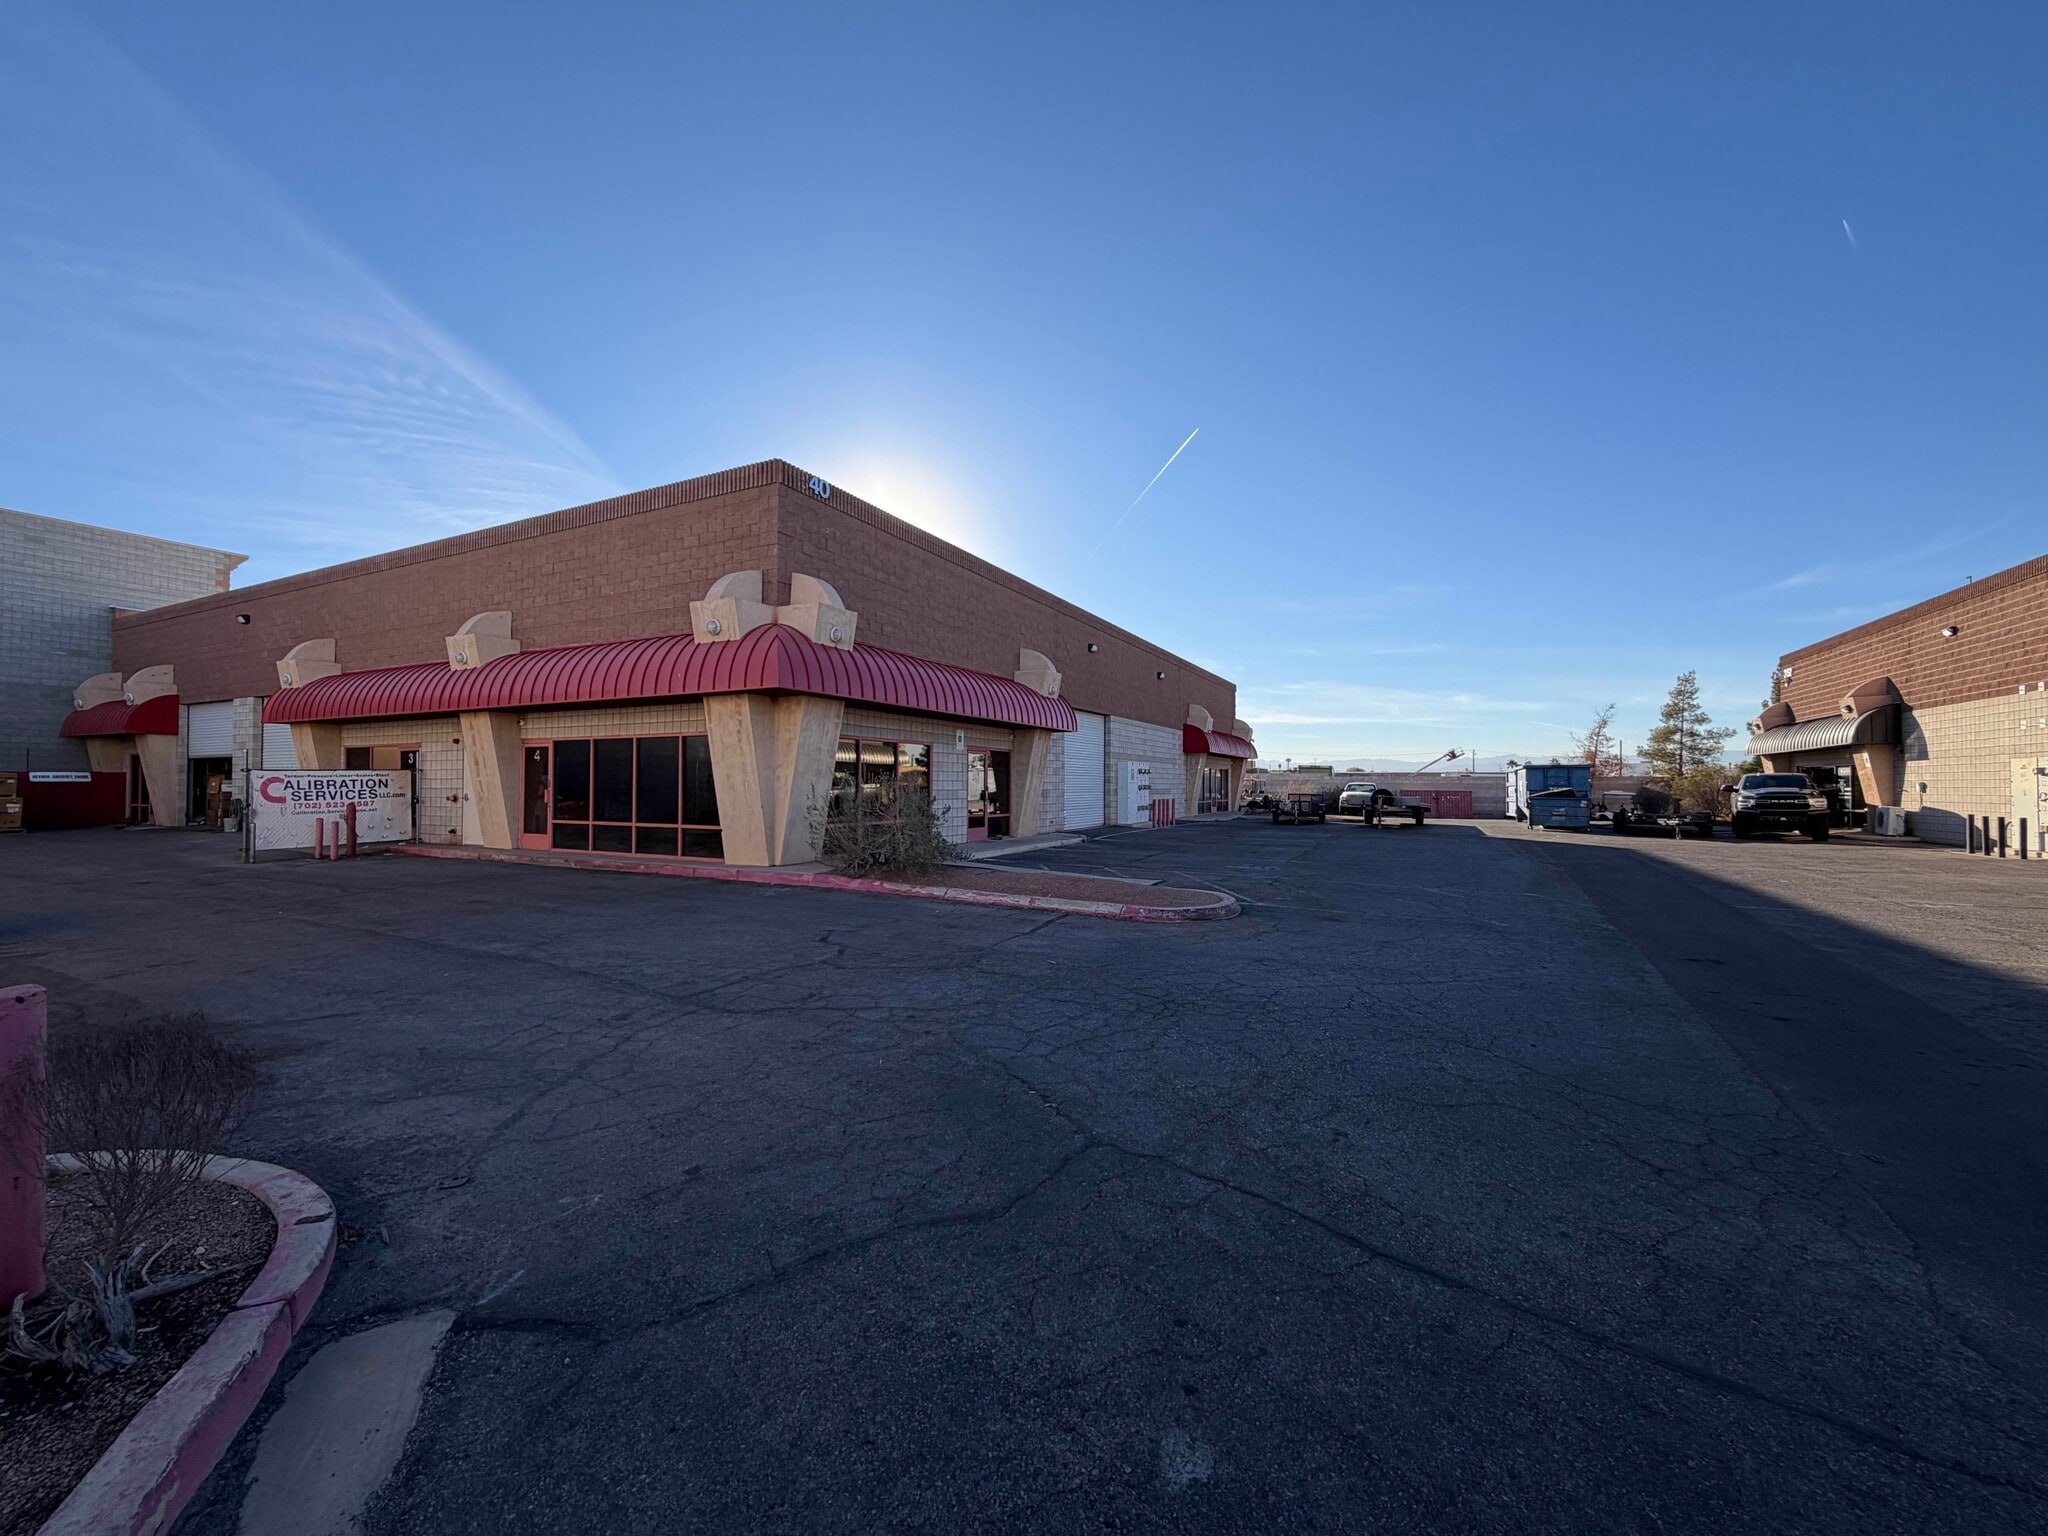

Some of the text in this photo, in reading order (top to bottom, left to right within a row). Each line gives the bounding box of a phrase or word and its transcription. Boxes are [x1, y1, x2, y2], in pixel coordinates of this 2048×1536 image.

[809, 476, 830, 499] 40
[408, 753, 414, 764] 3
[534, 750, 541, 761] 4
[260, 776, 389, 803] CALIBRATION
[291, 789, 379, 802] SERVICES
[293, 802, 322, 810] (702)
